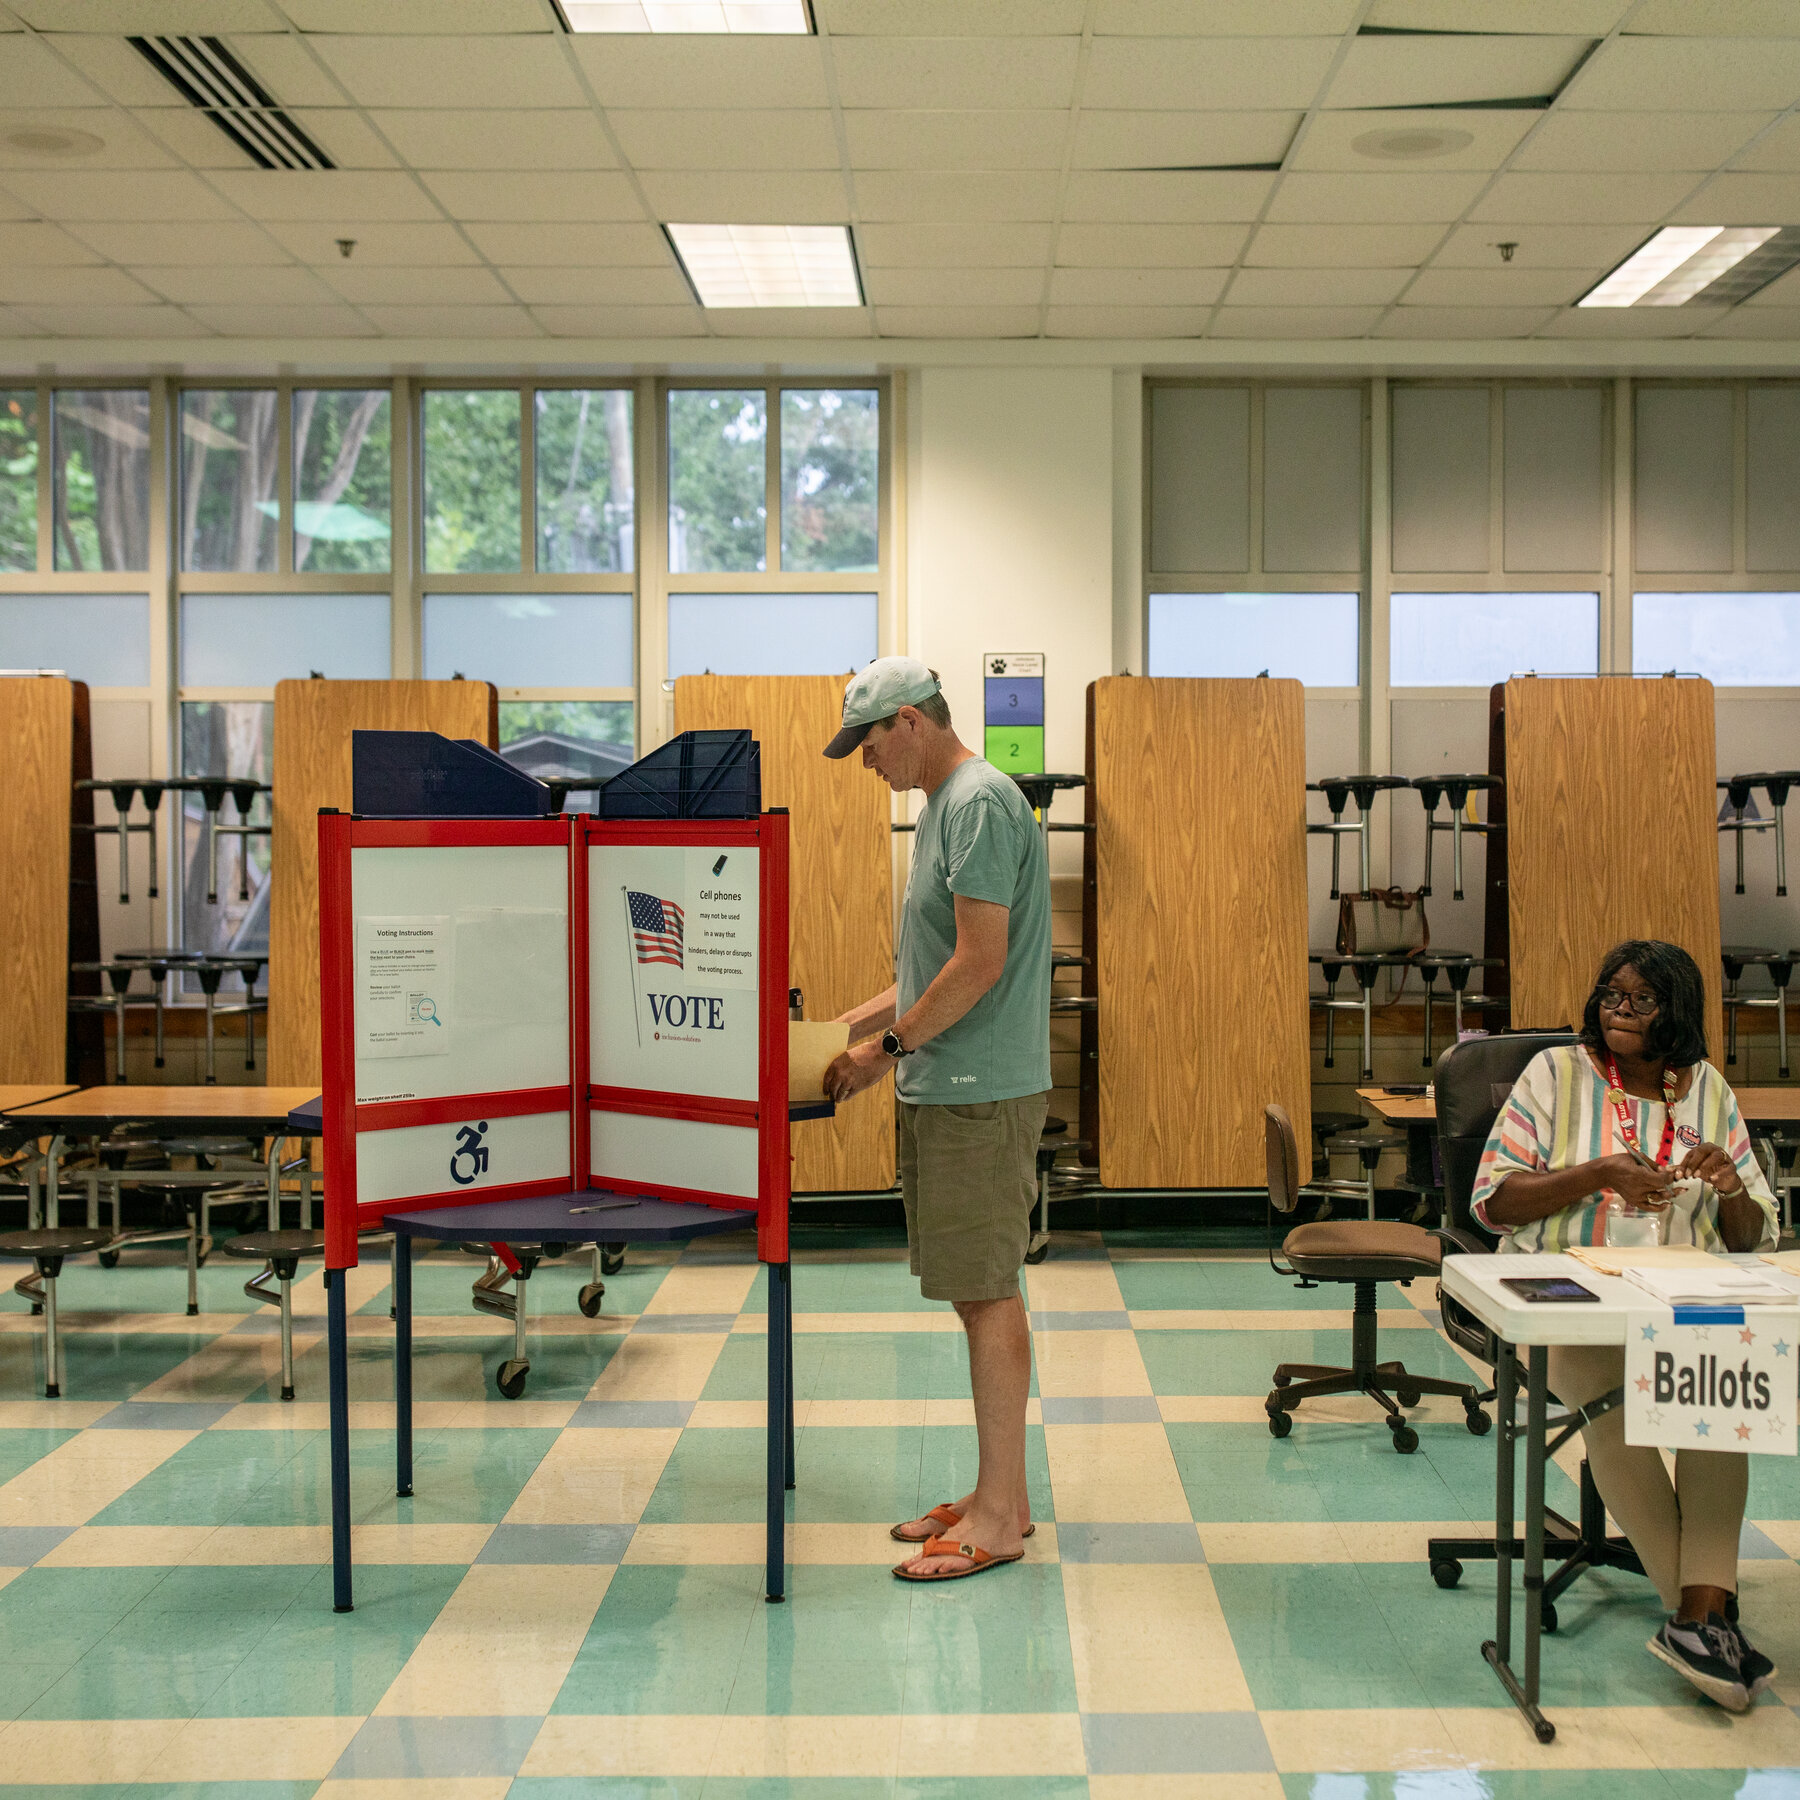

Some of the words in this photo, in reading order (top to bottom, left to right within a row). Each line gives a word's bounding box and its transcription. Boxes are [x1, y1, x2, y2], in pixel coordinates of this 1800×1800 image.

[1009, 694, 1018, 707] 3
[1010, 743, 1019, 757] 2
[700, 890, 712, 900] Cell
[714, 890, 741, 901] phones
[688, 947, 708, 955] hinders,
[709, 948, 725, 956] delays
[732, 949, 752, 958] disrupts
[707, 966, 722, 974] voting
[647, 993, 724, 1030] VOTE
[1609, 1066, 1617, 1078] CITY
[960, 1075, 977, 1083] relic
[1655, 1351, 1770, 1411] Ballots
